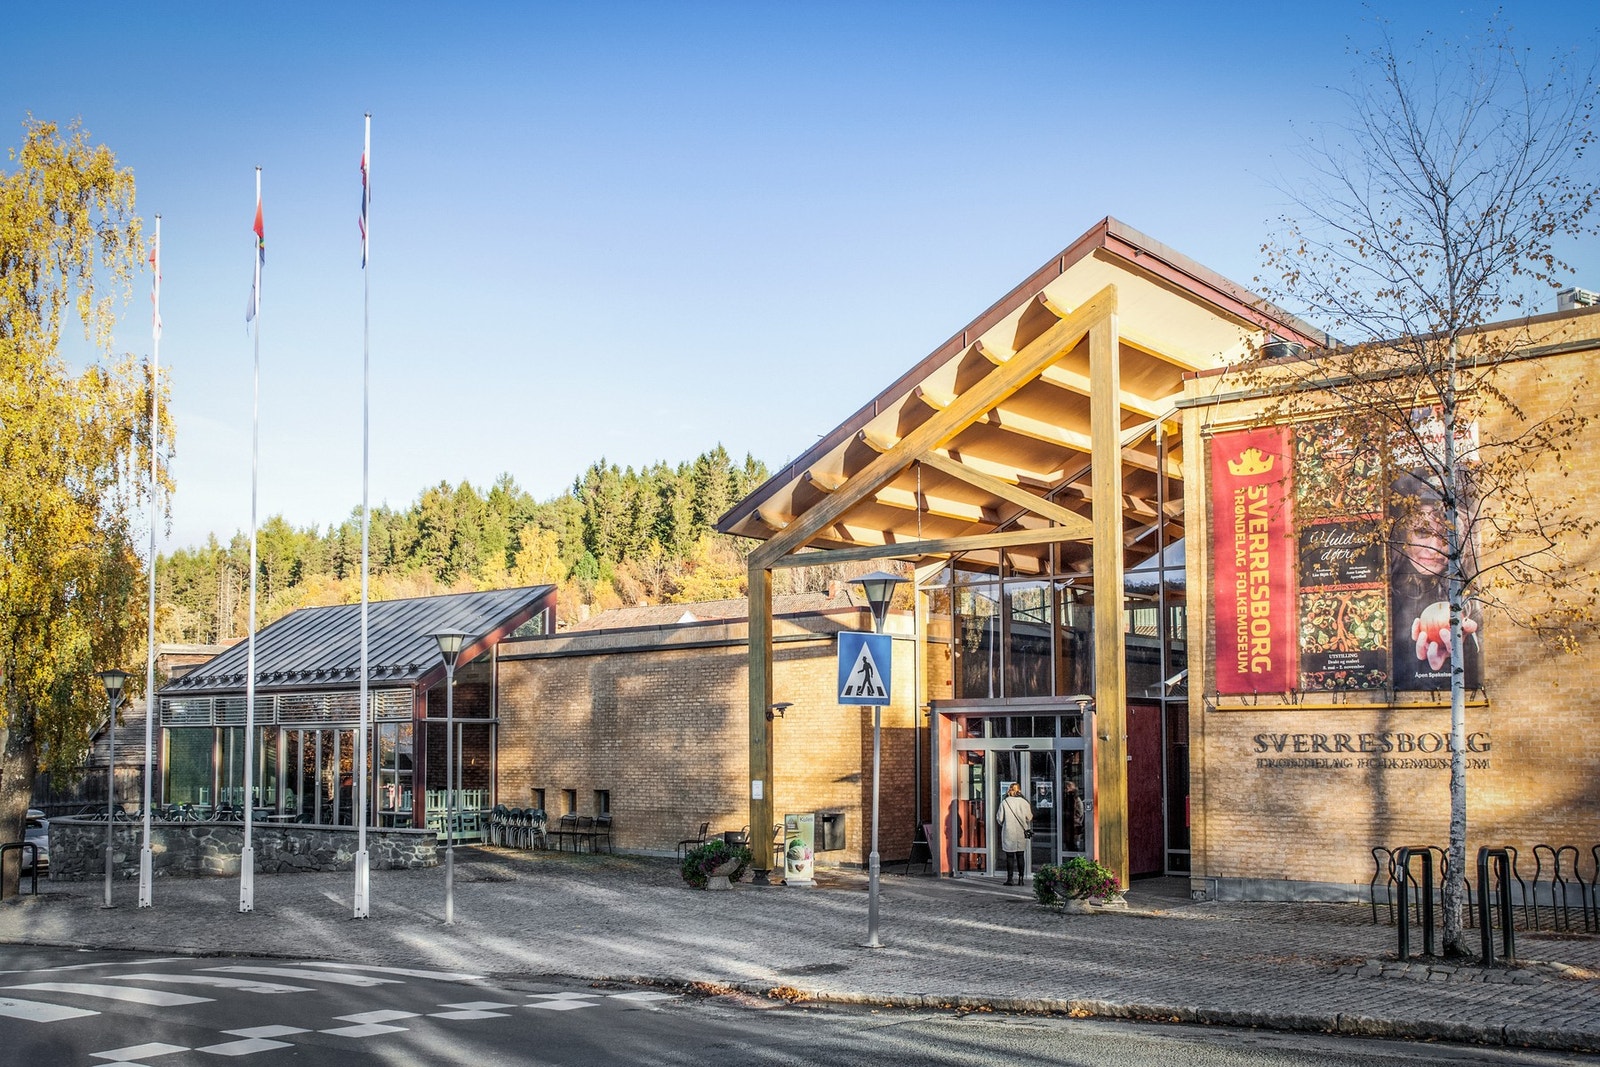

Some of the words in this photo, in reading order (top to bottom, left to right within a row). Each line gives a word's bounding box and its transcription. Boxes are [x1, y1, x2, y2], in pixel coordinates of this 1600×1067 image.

[1234, 487, 1246, 567] TRØNDELAG
[1236, 572, 1248, 673] FOLKEMUSEUM
[1248, 485, 1271, 674] SVERRESBORG
[1357, 758, 1491, 769] FOLKEMUSUM
